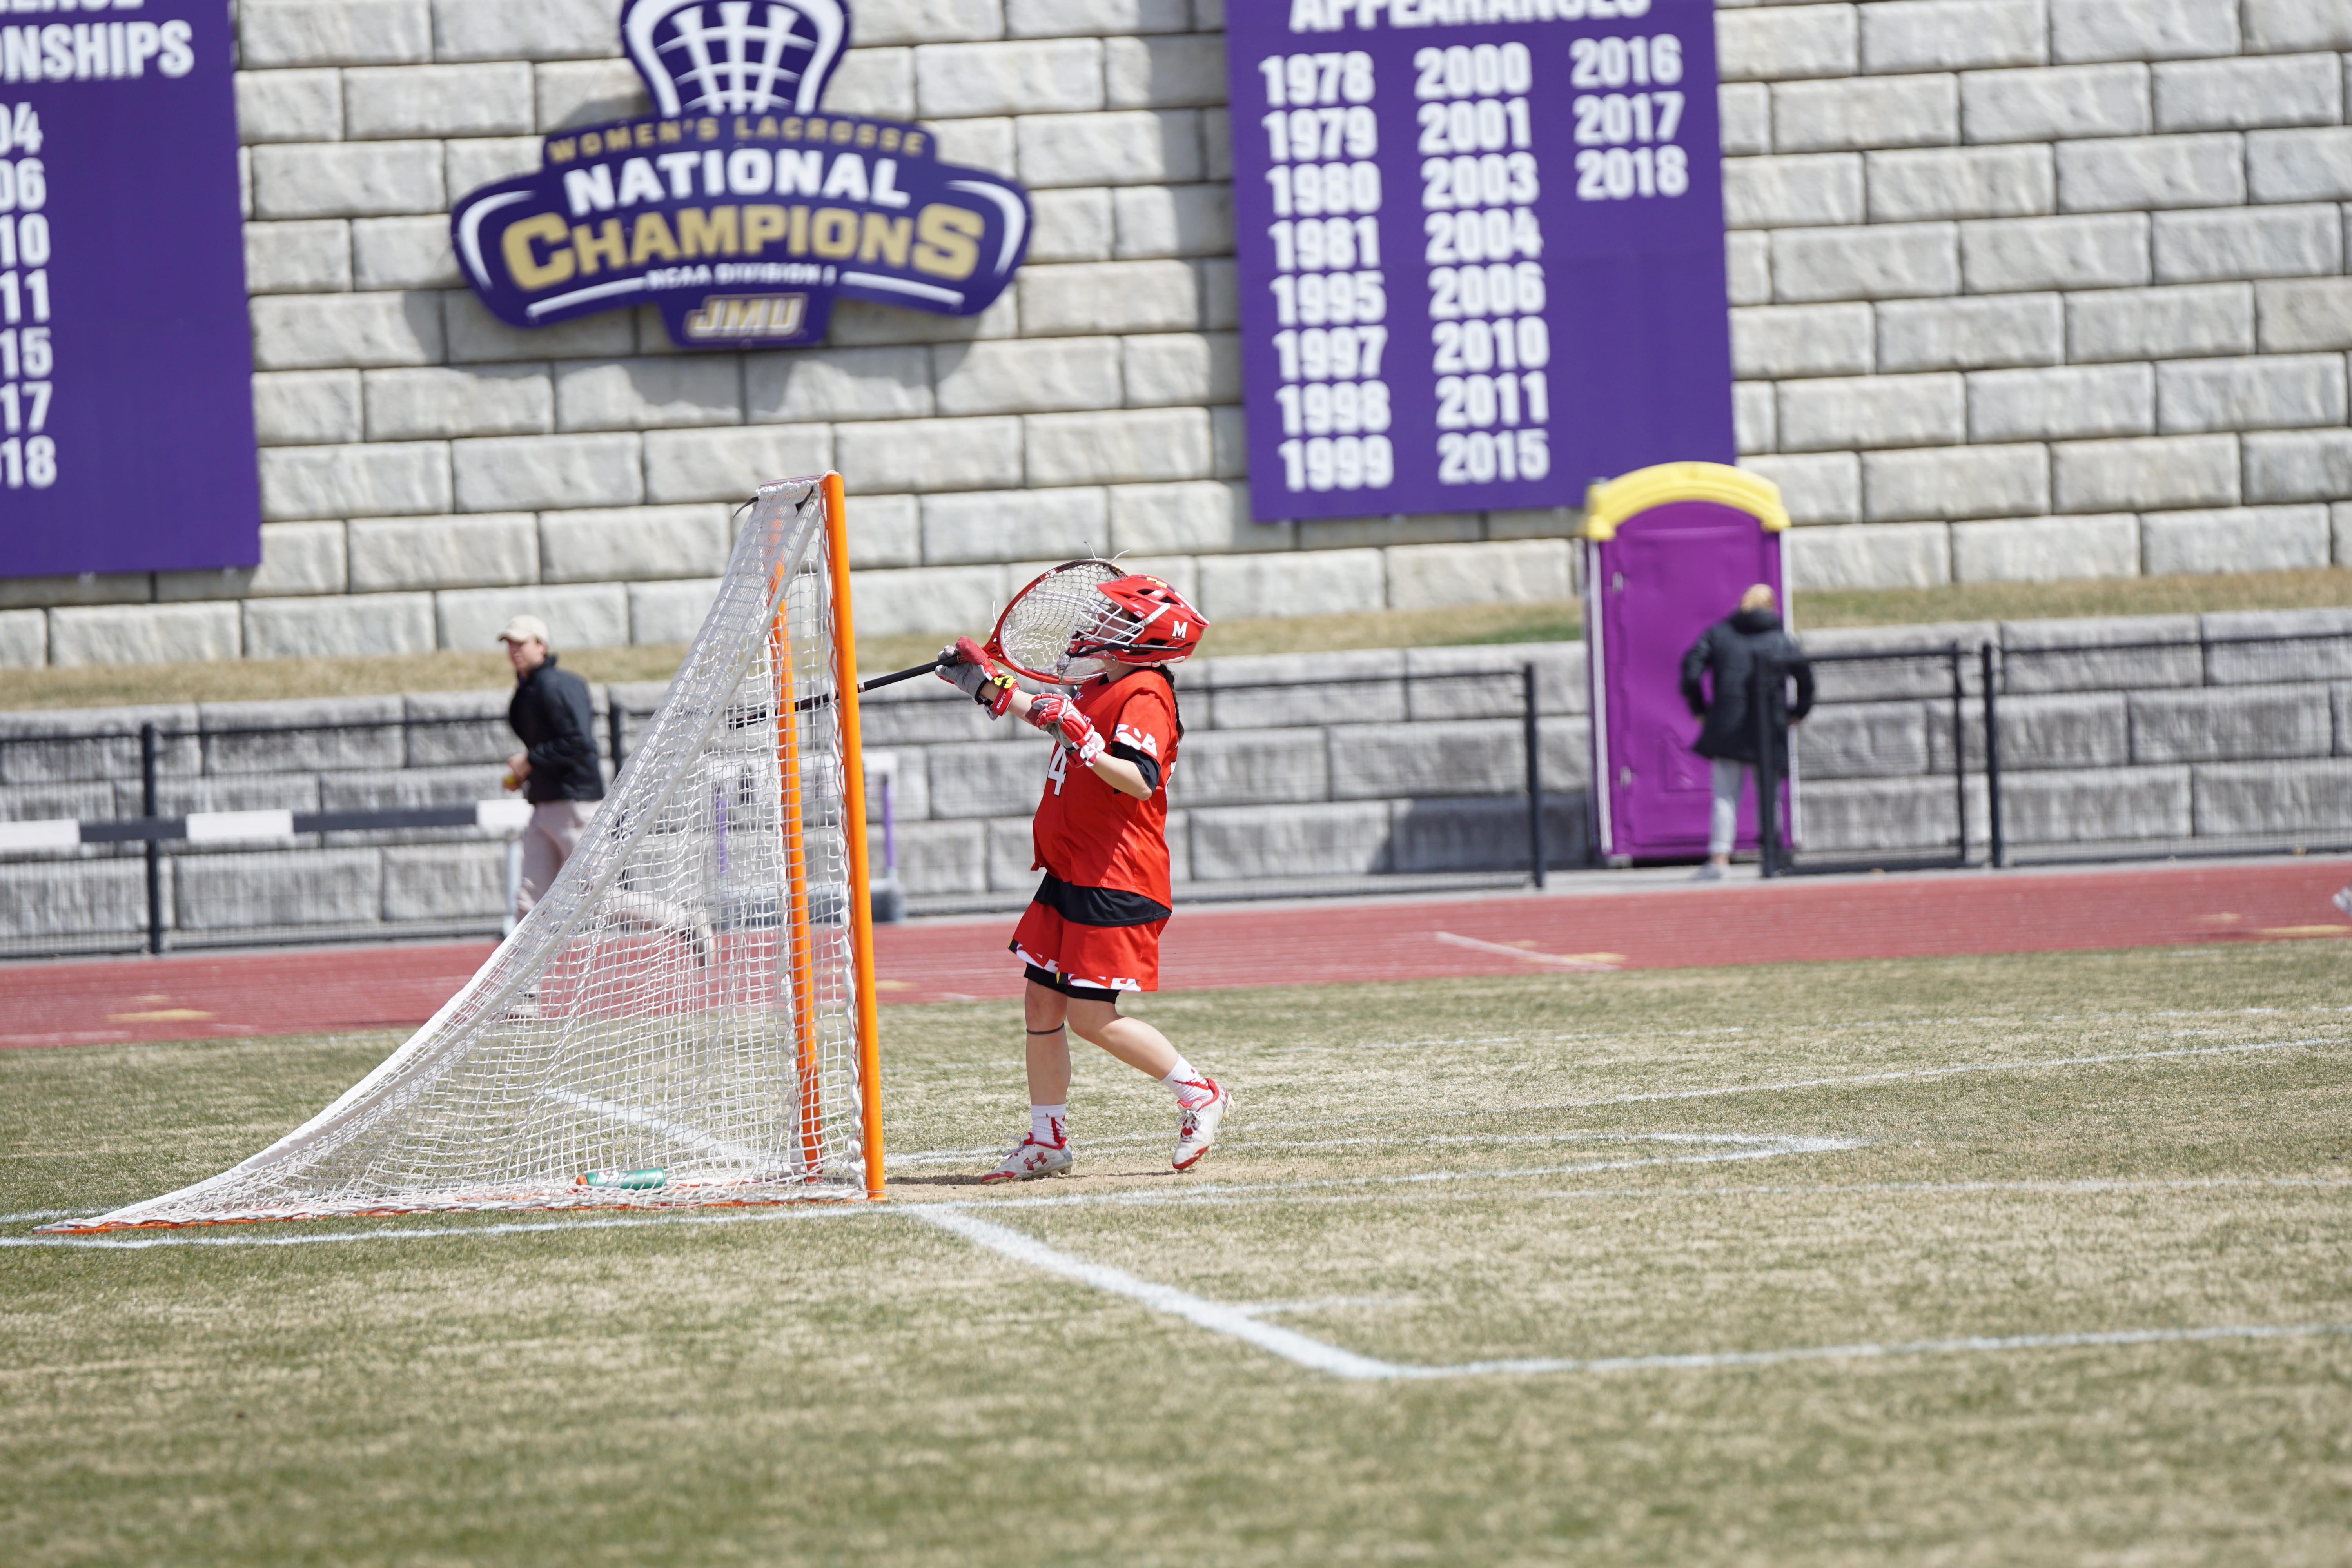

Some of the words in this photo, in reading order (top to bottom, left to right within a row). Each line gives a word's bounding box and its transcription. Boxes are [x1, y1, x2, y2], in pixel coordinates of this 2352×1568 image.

[0, 20, 194, 83] NSHIPS
[1259, 51, 1375, 107] 1978
[1414, 42, 1532, 100] 2000
[1570, 34, 1682, 88] 2016
[548, 117, 719, 164] WOMEN'S
[734, 116, 926, 157] LACROSSE
[1262, 106, 1377, 162] 1979
[1417, 97, 1531, 155] 2001
[1573, 91, 1684, 145] 2017
[563, 148, 911, 217] NATIONAL
[1266, 161, 1381, 217] 1980
[1421, 151, 1539, 210] 2003
[1575, 145, 1688, 200] 2018
[501, 202, 985, 292] CHAMPIONS
[1268, 216, 1380, 272] 1981
[1425, 207, 1543, 265] 2004
[646, 264, 713, 291] NCAA
[714, 262, 821, 285] DIVISION
[822, 265, 837, 287] I
[1270, 270, 1387, 327] 1995
[1428, 261, 1546, 320] 2006
[686, 296, 804, 338] JMU
[1432, 316, 1550, 374] 2010
[1272, 325, 1388, 382] 1997
[1275, 380, 1391, 436] 1998
[1435, 370, 1549, 429] 2011
[1278, 434, 1394, 492] 1999
[1437, 428, 1550, 484] 2015
[1171, 620, 1188, 638] M
